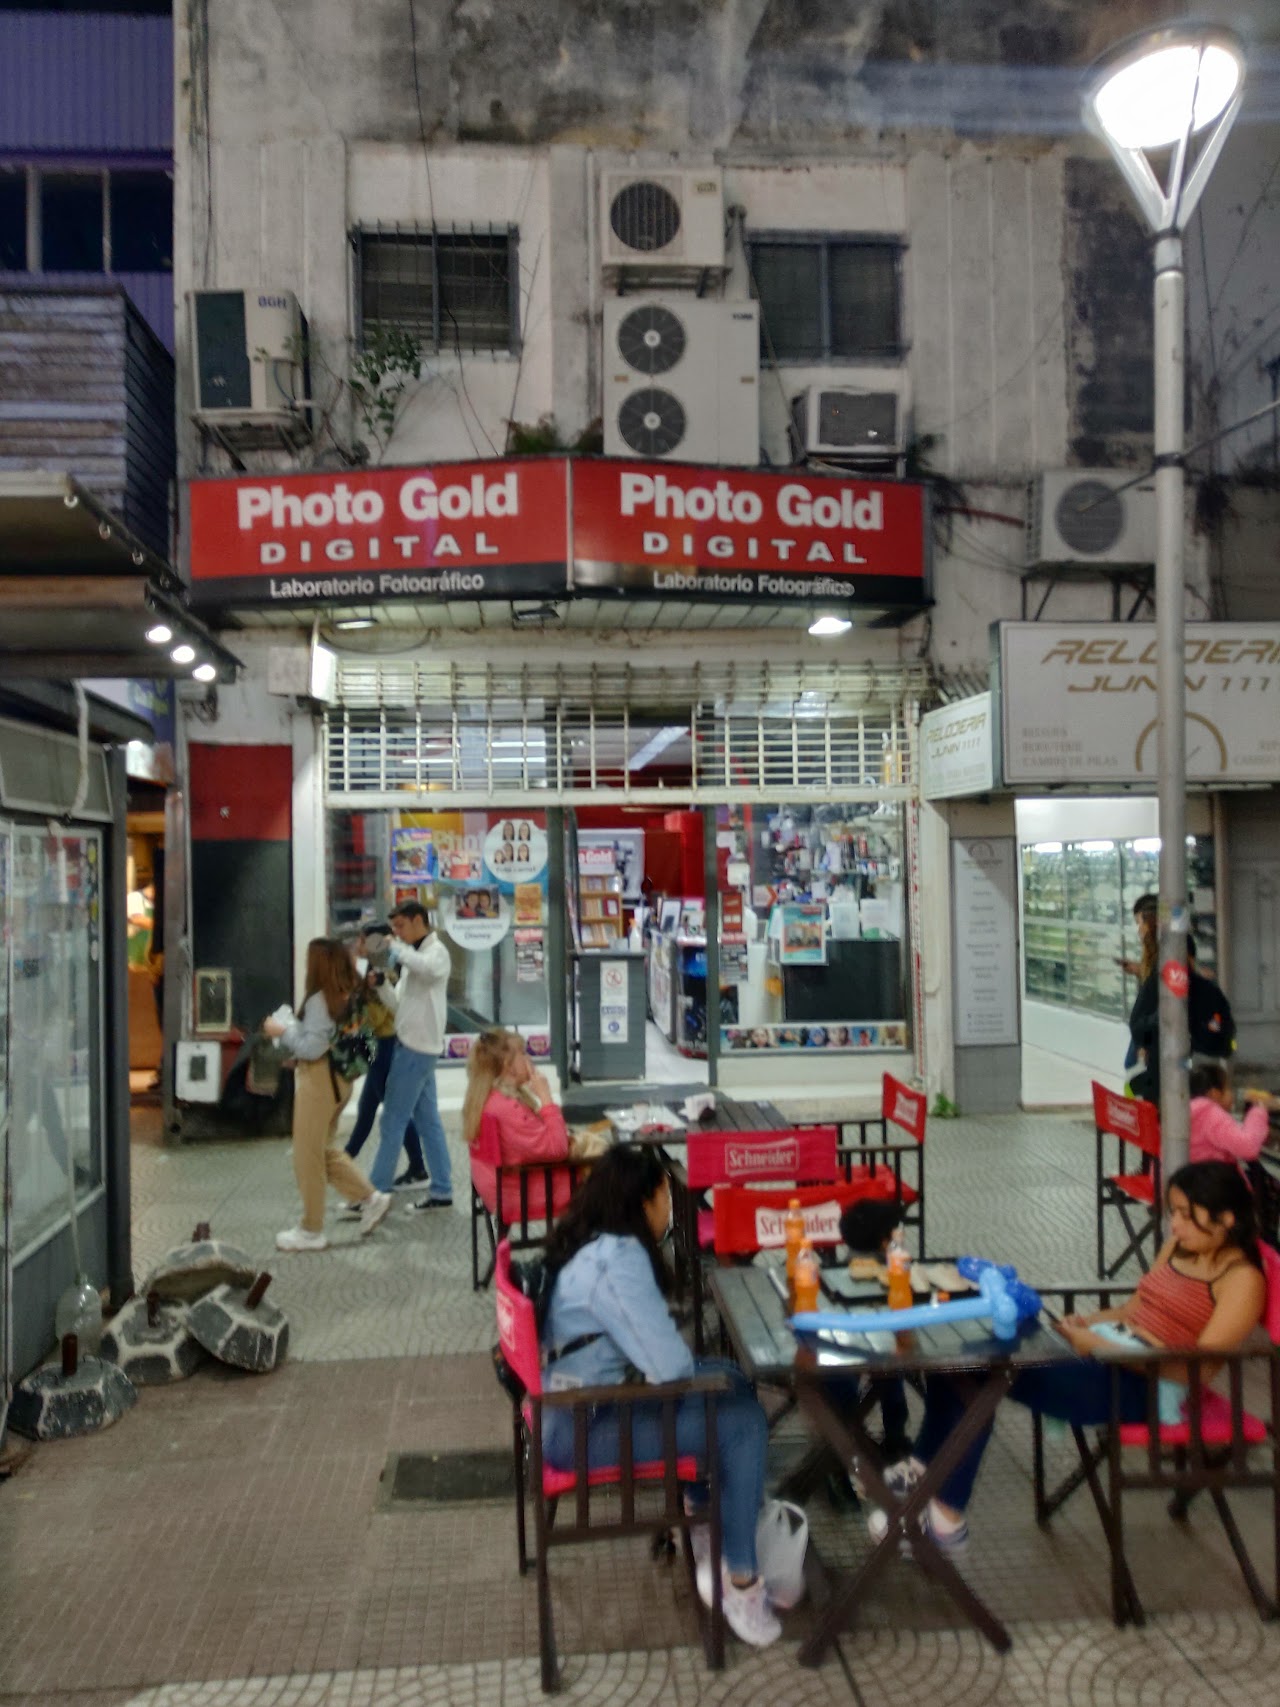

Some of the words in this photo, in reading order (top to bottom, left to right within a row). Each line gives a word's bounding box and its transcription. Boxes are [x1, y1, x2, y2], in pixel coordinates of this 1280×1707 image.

[258, 295, 287, 309] BGH
[237, 486, 384, 531] Photo
[399, 472, 519, 520] Gold
[619, 472, 763, 525] Photo
[777, 484, 883, 532] Gold
[260, 532, 499, 565] DIGITAL
[643, 532, 868, 563] DIGITAL
[270, 573, 375, 598] Laboratorio
[379, 569, 486, 595] Fotográfico
[653, 571, 753, 594] Laboratorio
[758, 574, 855, 598] Fotográfico
[729, 1146, 796, 1169] Schneider
